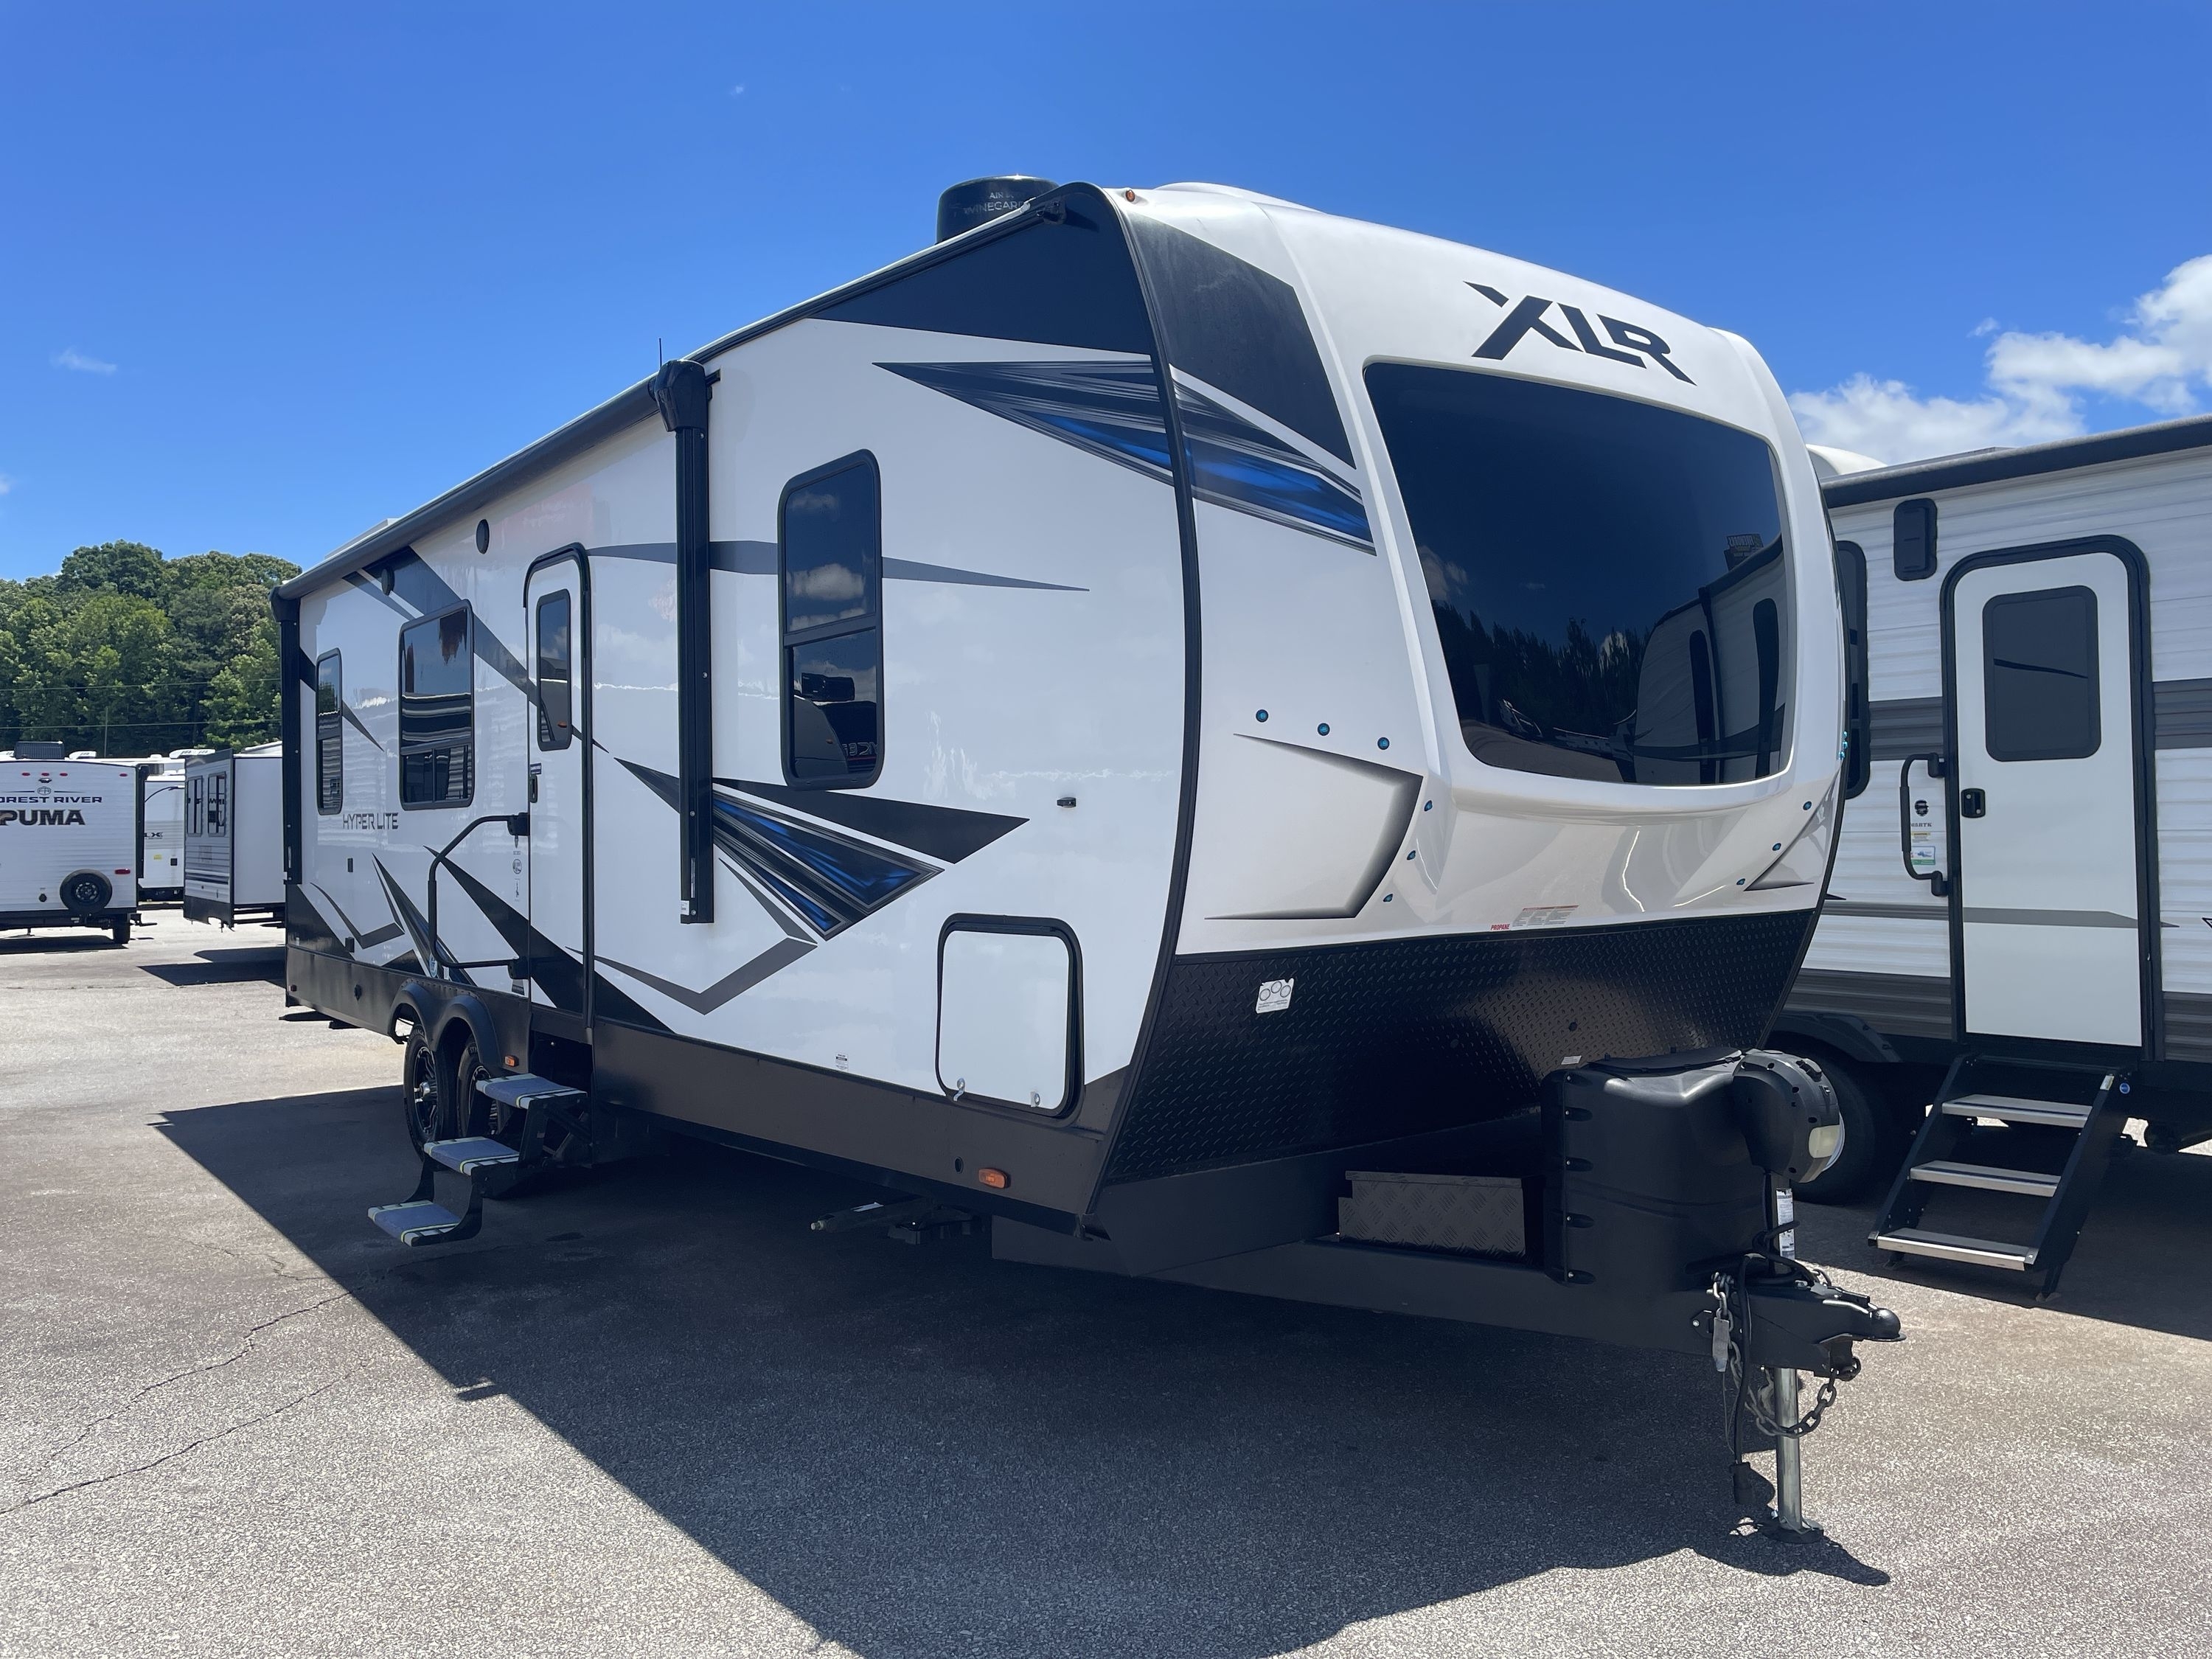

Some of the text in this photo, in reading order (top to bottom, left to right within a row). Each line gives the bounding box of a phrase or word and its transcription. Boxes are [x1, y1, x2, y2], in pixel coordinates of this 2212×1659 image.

[1463, 279, 1697, 386] XLR
[0, 810, 86, 826] PUMA
[343, 813, 399, 830] HYPER LITE
